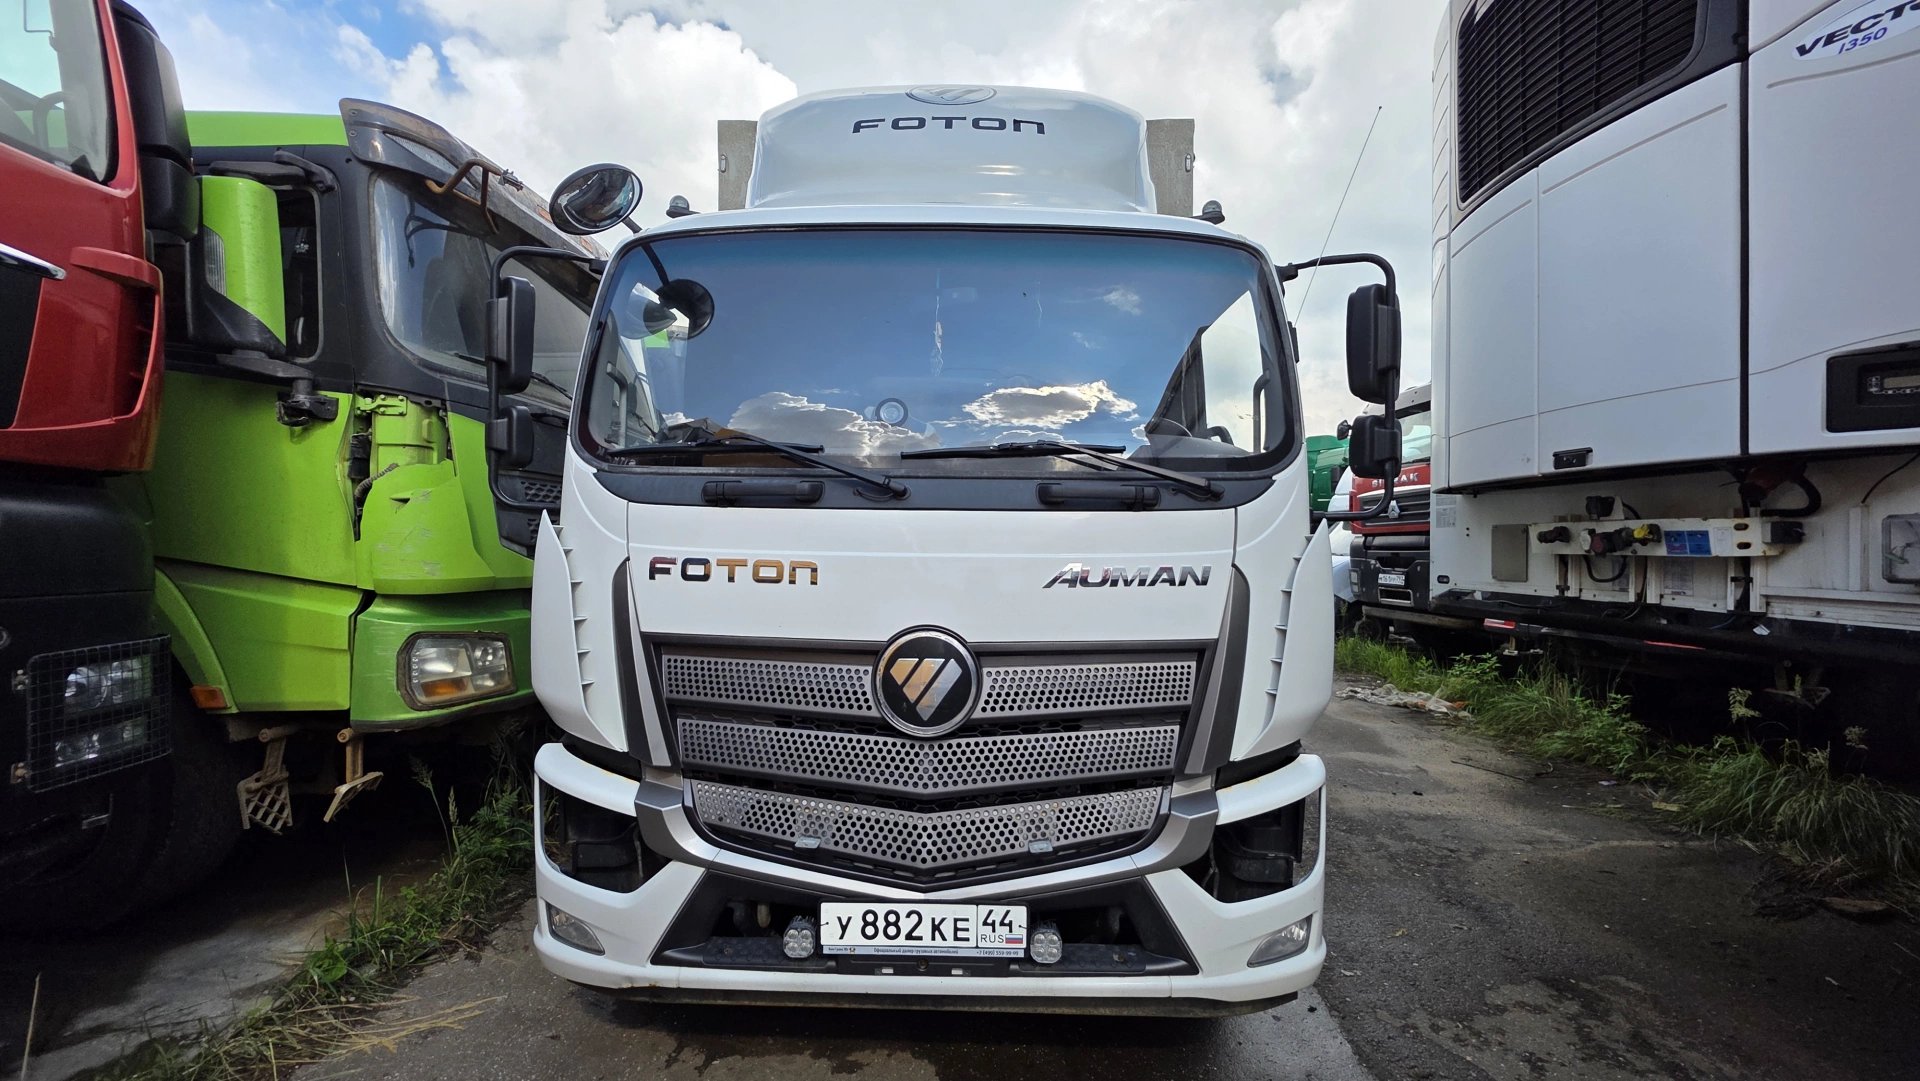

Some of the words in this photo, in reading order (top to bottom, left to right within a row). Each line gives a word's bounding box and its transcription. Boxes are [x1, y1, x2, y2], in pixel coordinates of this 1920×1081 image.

[1795, 0, 1920, 57] VECT
[1838, 26, 1888, 55] 1350
[852, 116, 1046, 135] FOTON
[648, 556, 819, 586] FOTON
[1042, 562, 1212, 589] AUMAN
[981, 908, 1014, 934] 44
[980, 934, 1005, 944] RUS
